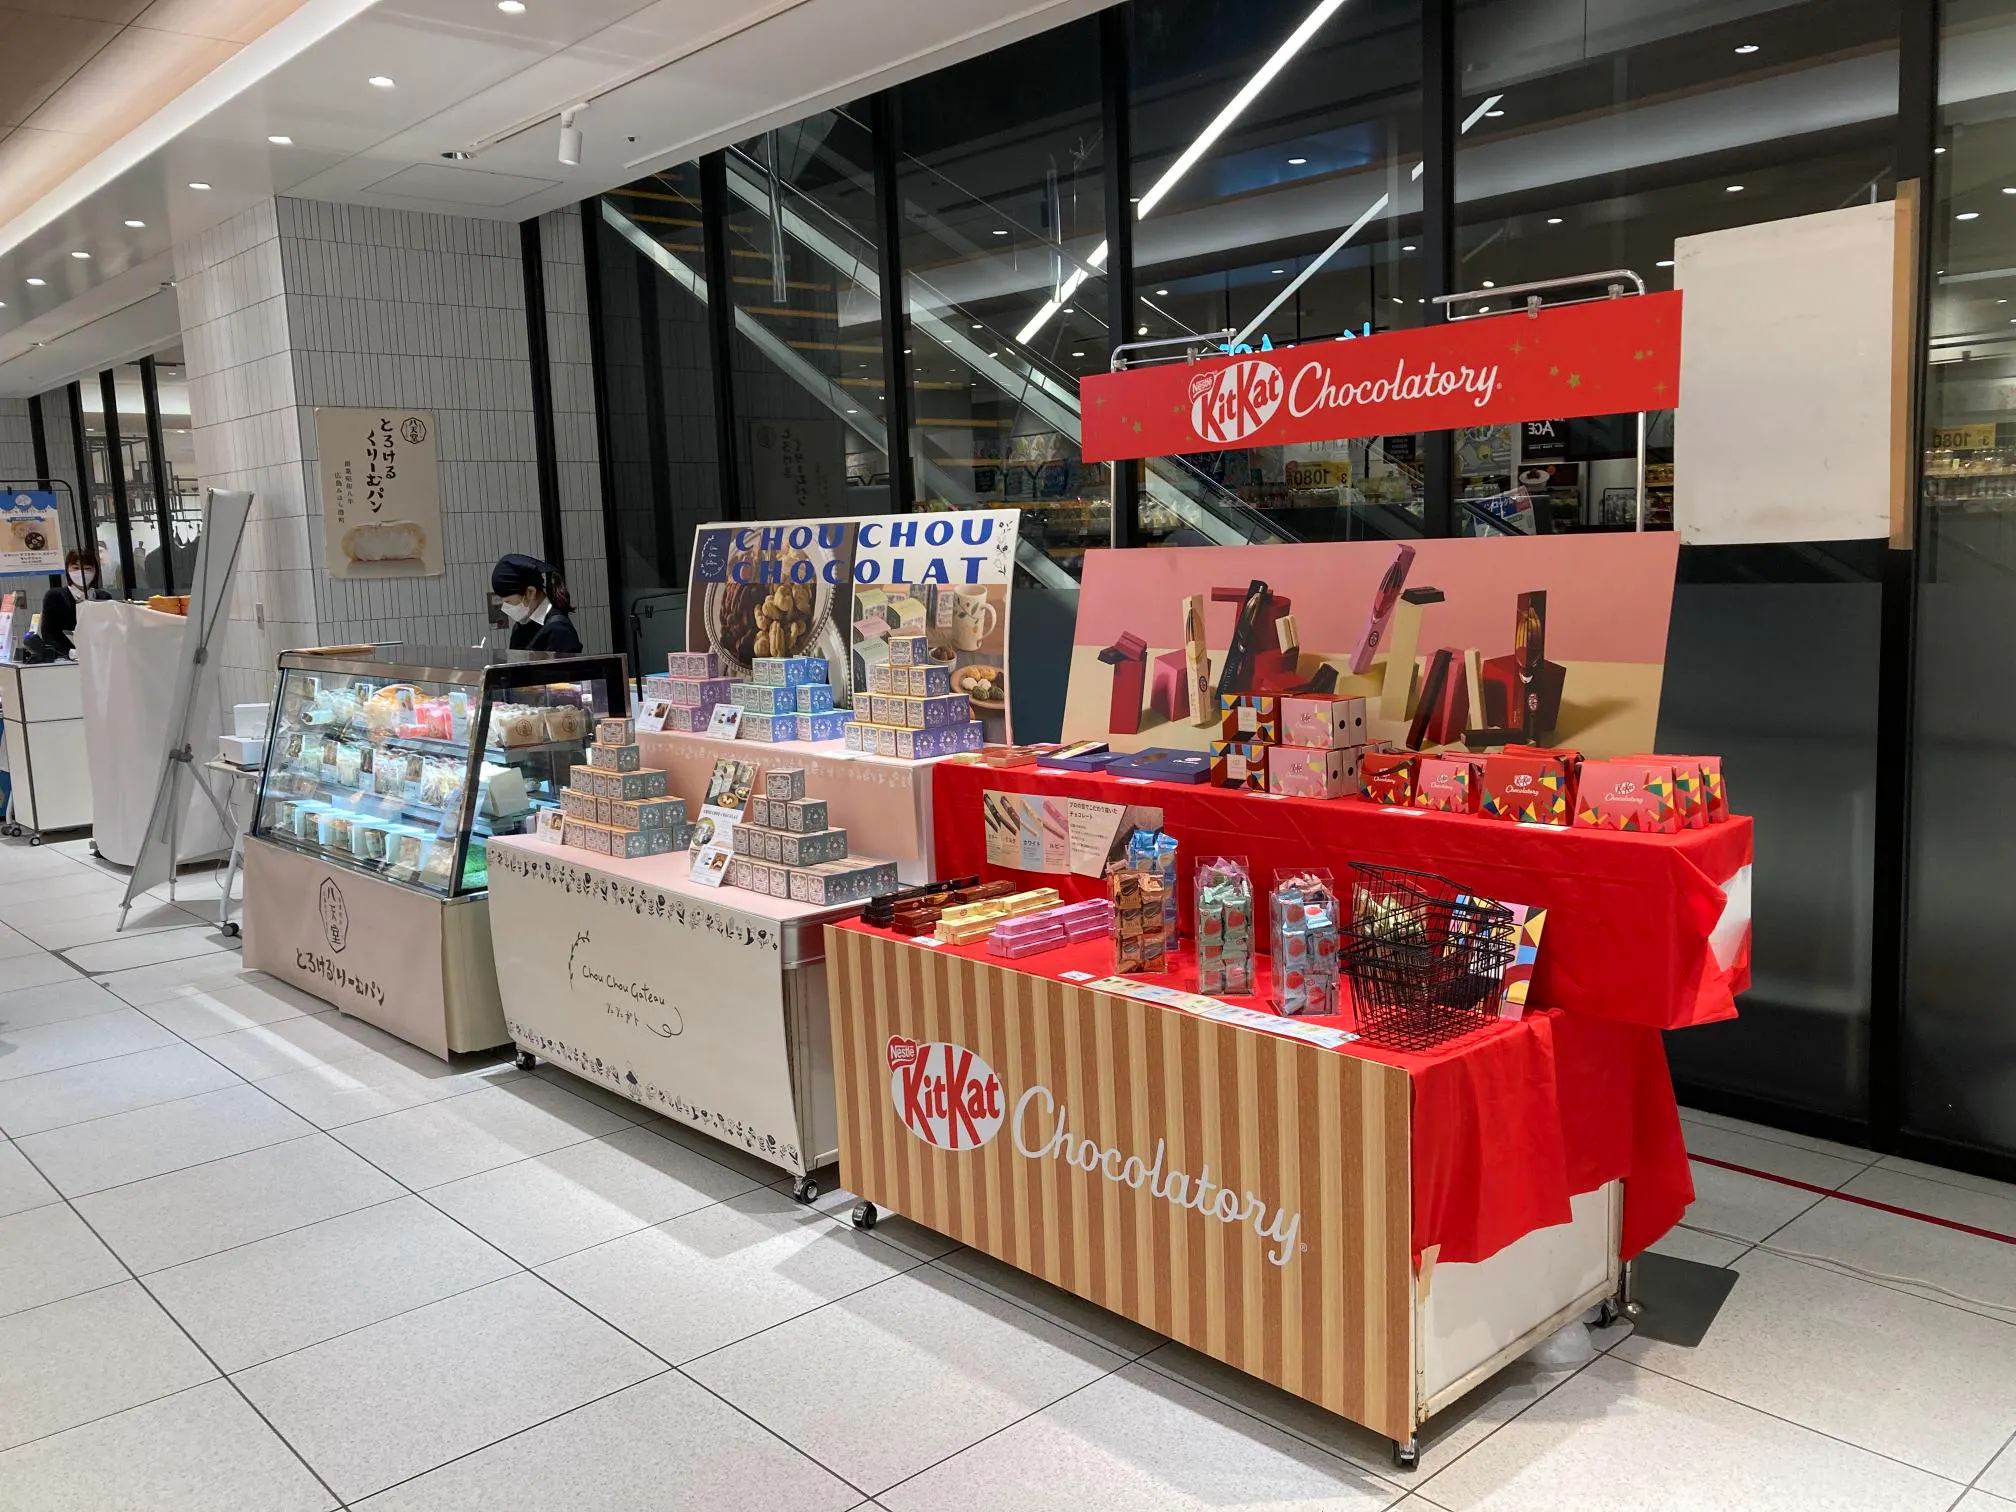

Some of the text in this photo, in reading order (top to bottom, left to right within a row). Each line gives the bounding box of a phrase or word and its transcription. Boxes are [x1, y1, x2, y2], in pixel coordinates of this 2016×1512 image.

[1199, 357, 1498, 442] KitKat Chocolatory
[366, 428, 384, 513] くりーむパン
[380, 418, 396, 480] とろける
[736, 518, 994, 551] CHOU CHOU
[731, 556, 988, 585] CHOCOLAT
[1023, 839, 1041, 847] ホワイト
[583, 965, 665, 1005] Chou Chou Gateau
[903, 1045, 1300, 1266] KitKat Chocolatory
